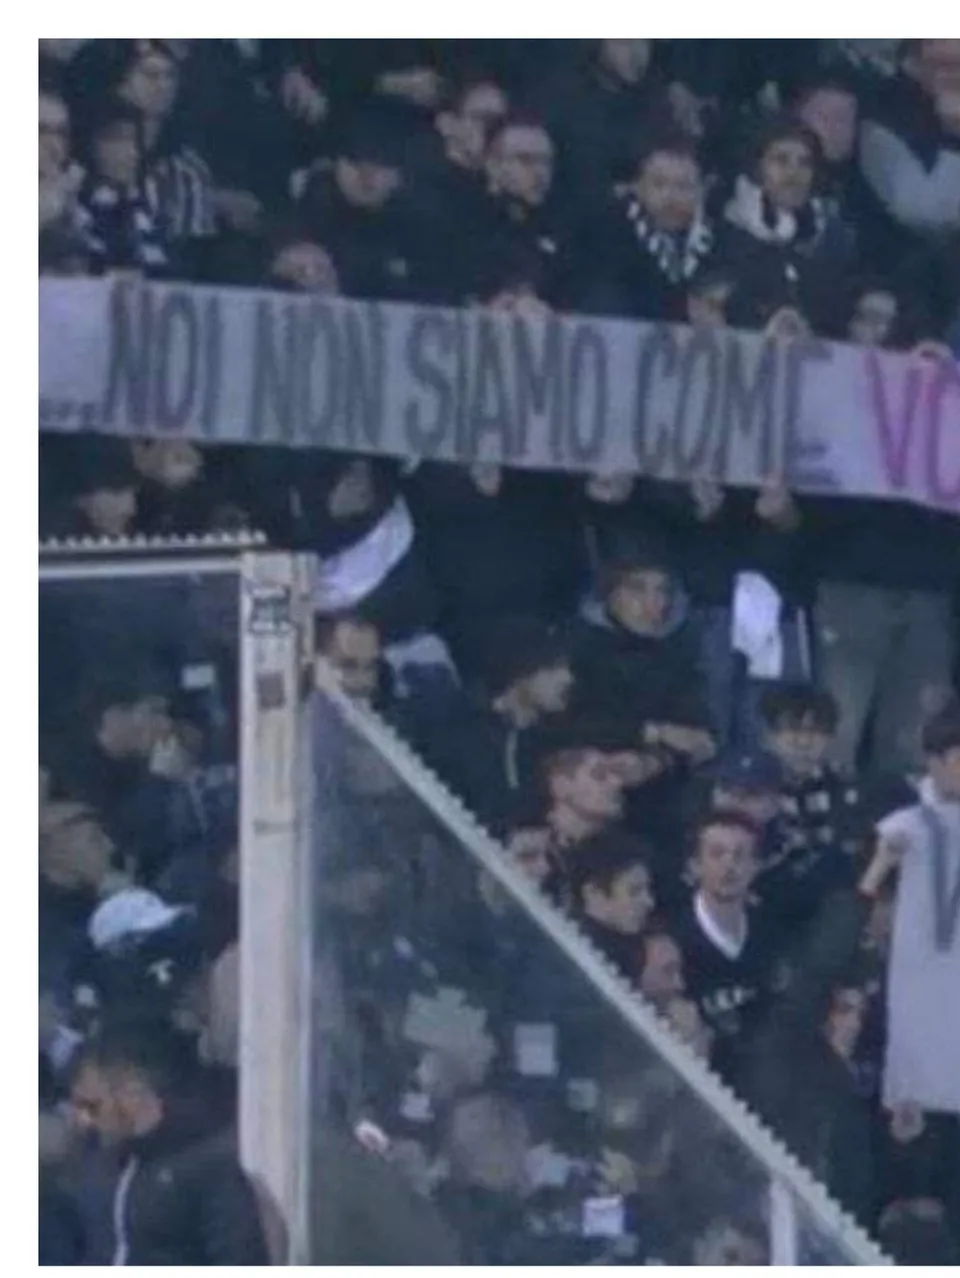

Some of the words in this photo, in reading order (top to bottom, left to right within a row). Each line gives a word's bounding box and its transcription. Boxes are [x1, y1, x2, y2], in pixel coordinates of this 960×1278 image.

[250, 300, 384, 446] NON
[404, 312, 606, 464] SIAMO
[632, 322, 838, 490] COME
